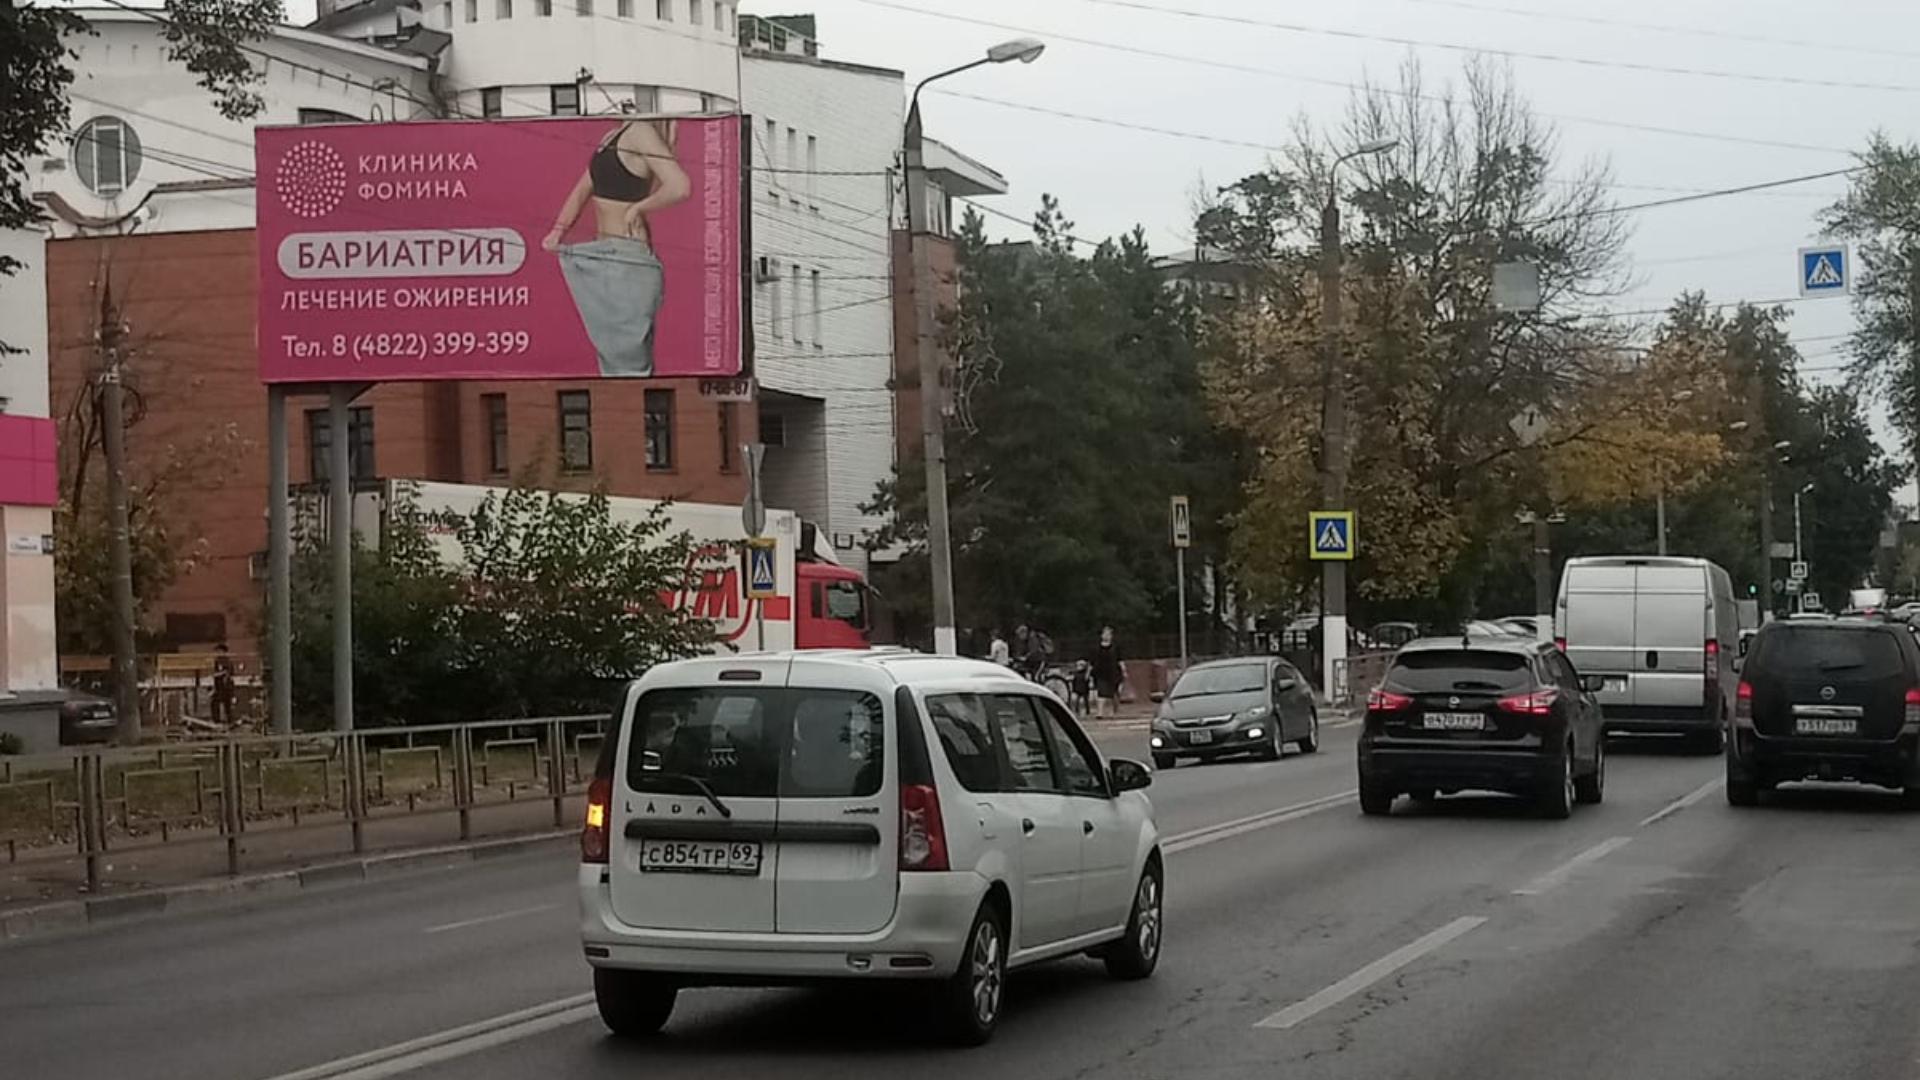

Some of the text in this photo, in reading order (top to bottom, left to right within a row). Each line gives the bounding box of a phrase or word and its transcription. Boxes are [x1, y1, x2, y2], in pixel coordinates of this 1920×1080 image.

[359, 152, 478, 174] КЛИНИКА
[358, 180, 467, 200] ФОМИНА
[298, 238, 505, 270] БАРИАТРИЯ
[281, 286, 529, 310] ЛЕЧЕНИЕ ОЖИРЕНИЯ
[281, 331, 529, 361] Тел. 8 (4822) 399-399
[625, 801, 706, 815] LADA
